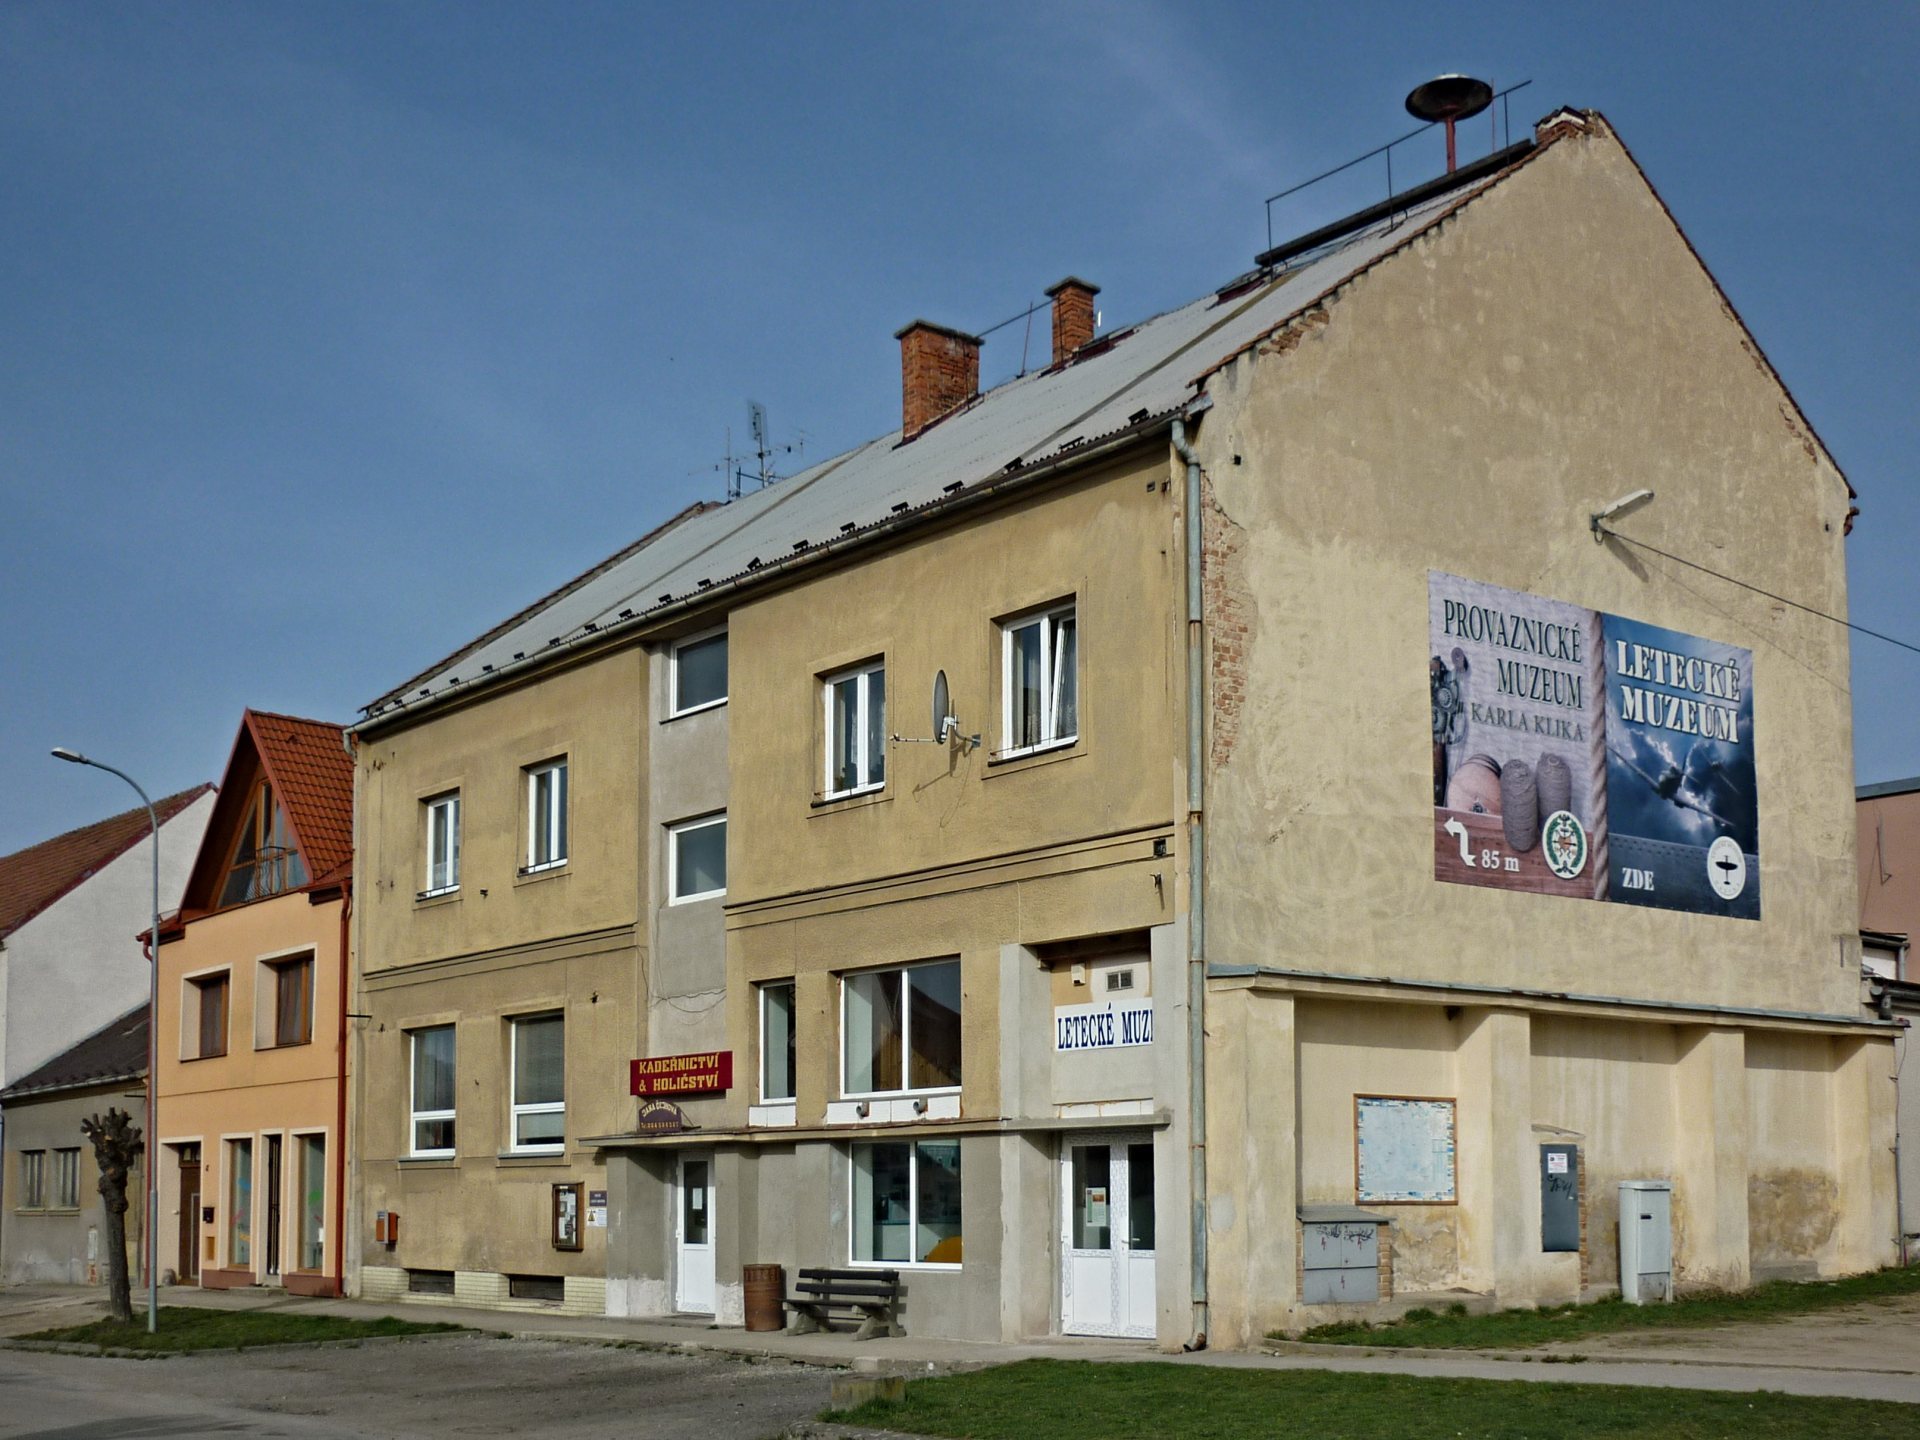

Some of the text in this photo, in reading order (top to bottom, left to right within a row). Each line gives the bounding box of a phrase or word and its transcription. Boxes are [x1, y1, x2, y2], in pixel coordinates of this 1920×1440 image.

[1443, 599, 1582, 663] PROVAZNICKÉ
[1497, 658, 1582, 709] MUZEUM
[1616, 640, 1740, 702] LETECKÉ
[1471, 702, 1584, 742] KARLA KLIKA
[1621, 684, 1739, 743] MUZEUM
[1481, 849, 1520, 872] 85 m
[1622, 867, 1655, 891] ZDE
[1057, 1001, 1153, 1049] LETECKÉ MUZ
[639, 1052, 720, 1074] KADEŘNICTVÍ
[639, 1071, 719, 1092] & HOLIČSTVÍ
